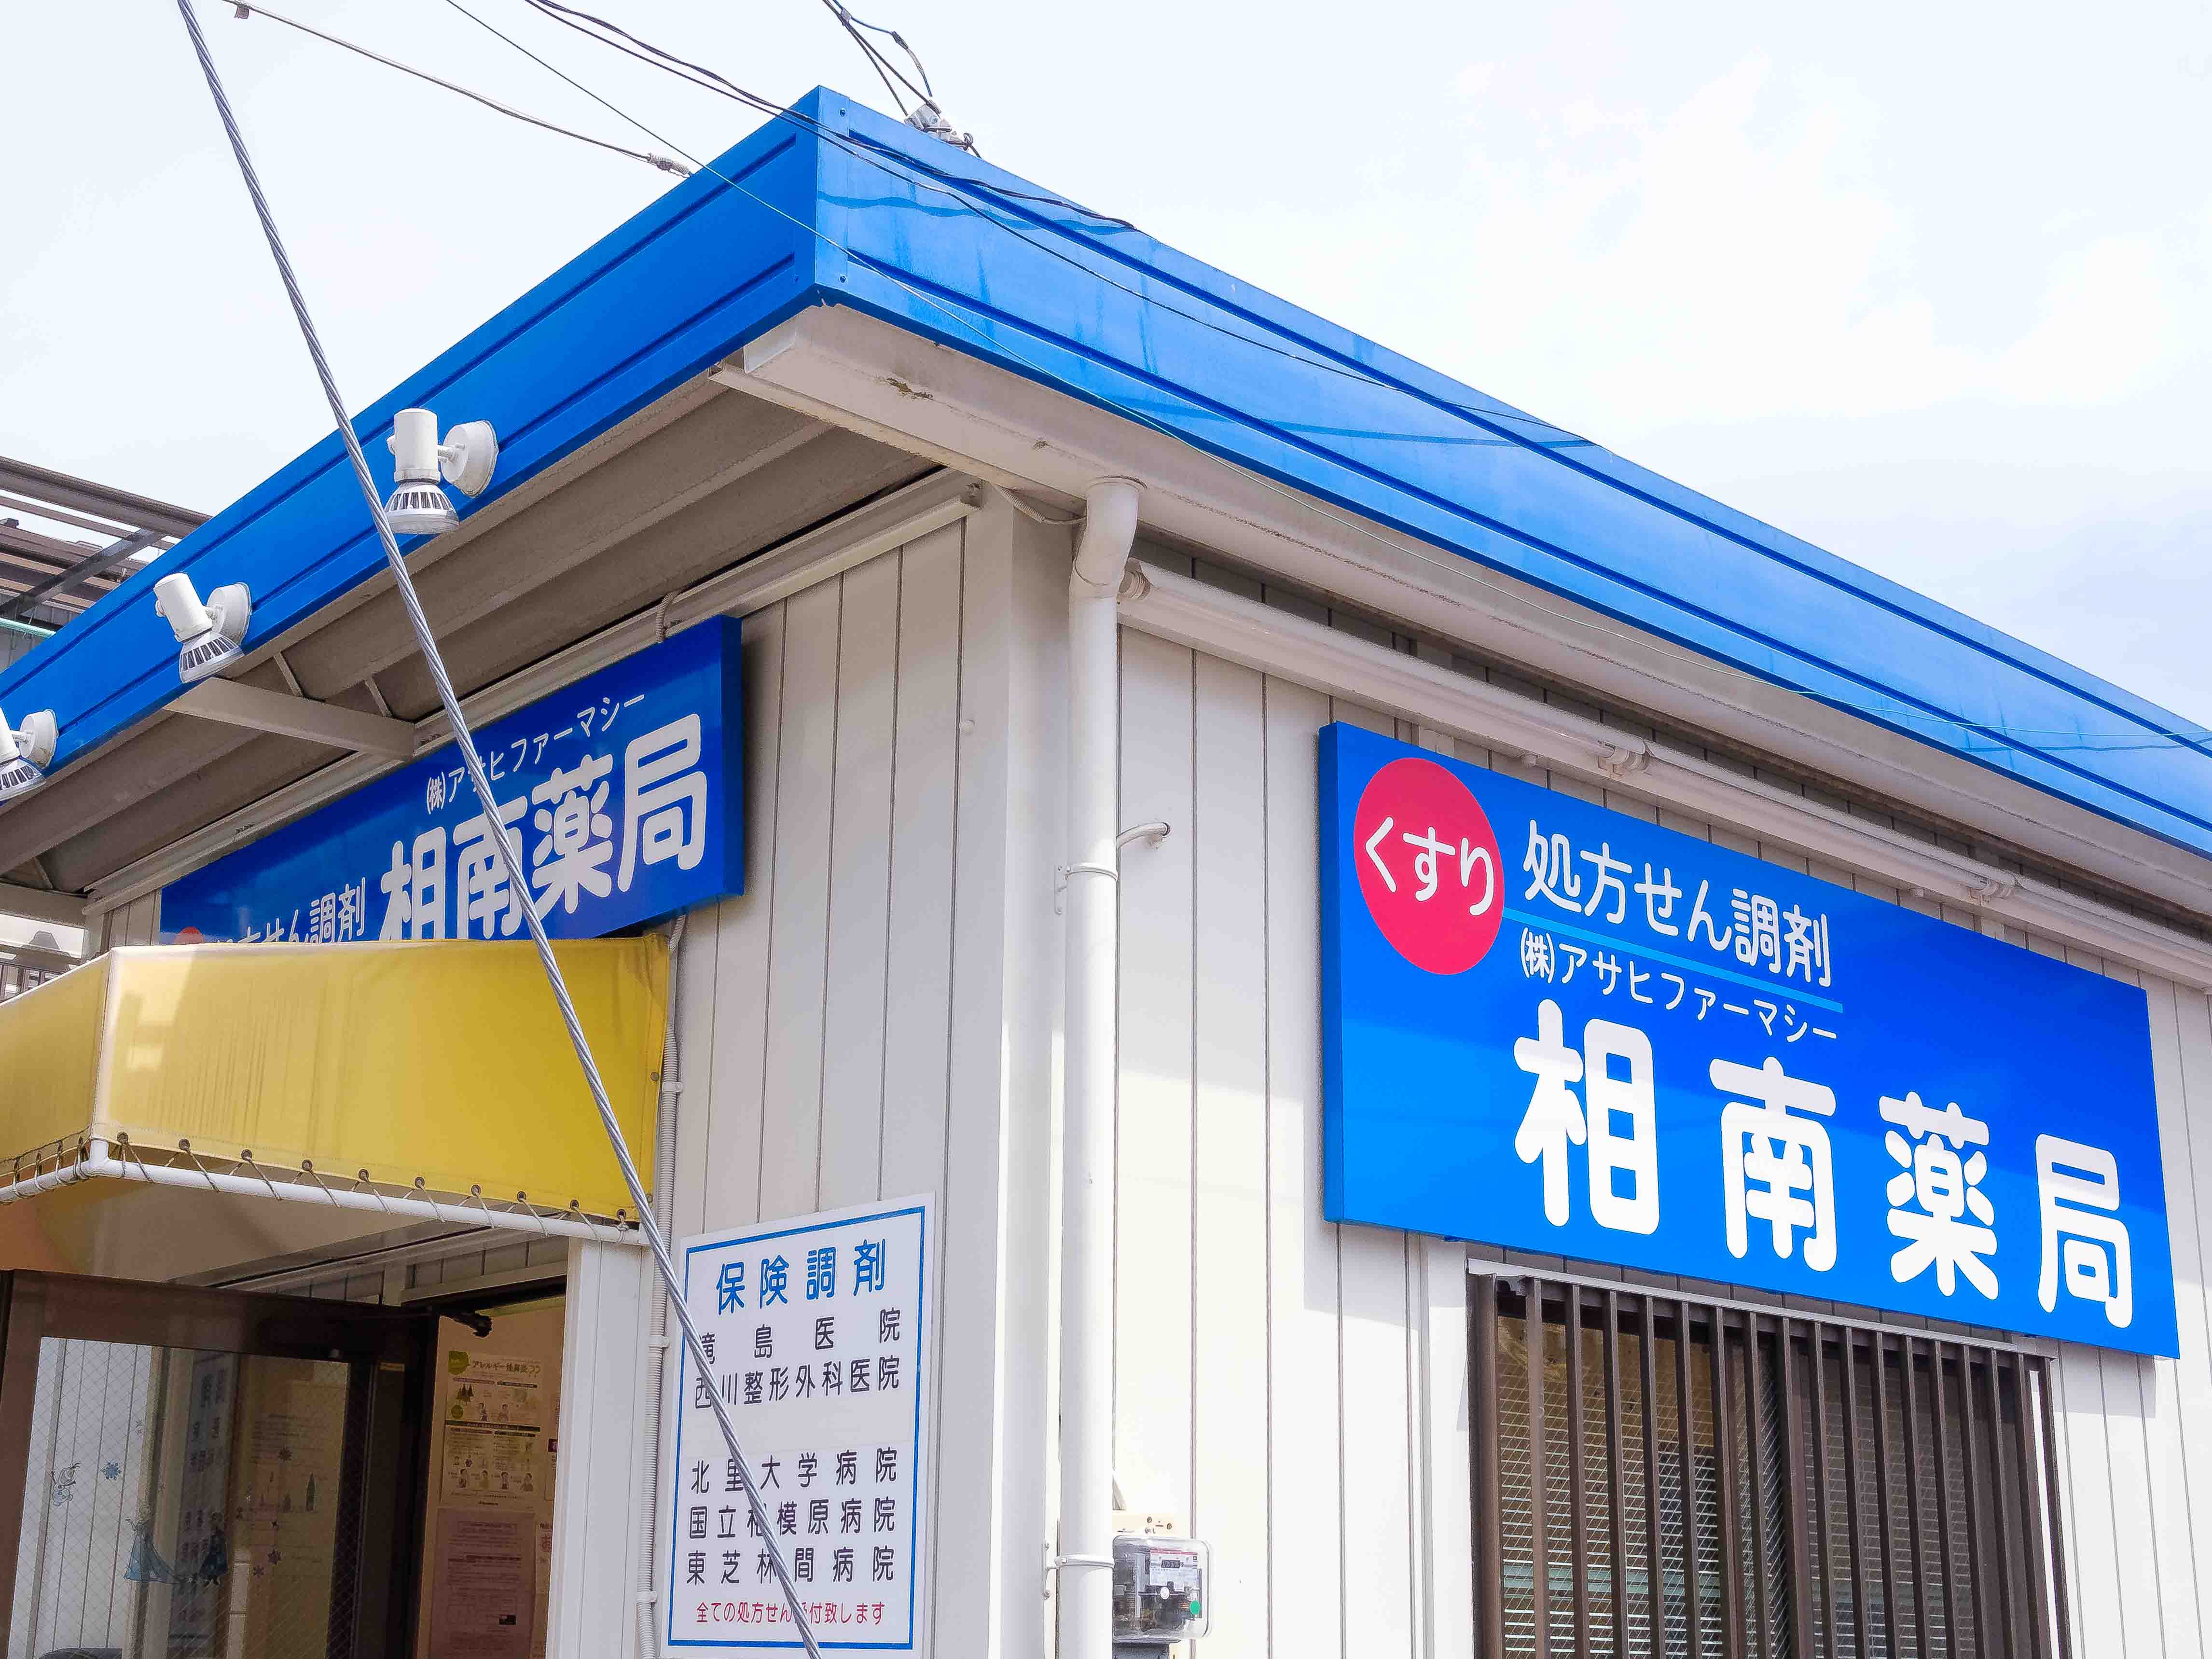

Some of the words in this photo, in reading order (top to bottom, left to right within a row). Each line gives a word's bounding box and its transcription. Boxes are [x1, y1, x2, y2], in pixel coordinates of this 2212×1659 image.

[381, 713, 707, 939] 相南薬局
[1365, 816, 1494, 916] くすり
[1523, 819, 1832, 988] 処方せん調剤
[1513, 998, 2133, 1329] 相南薬局
[716, 1239, 885, 1315] 保険調剤
[695, 1355, 899, 1409] 西川整形外科医院
[691, 1447, 897, 1494] 北里大学病院
[687, 1546, 895, 1585] 東芝林間病院
[695, 1602, 885, 1625] 全ての処方せん付致します
